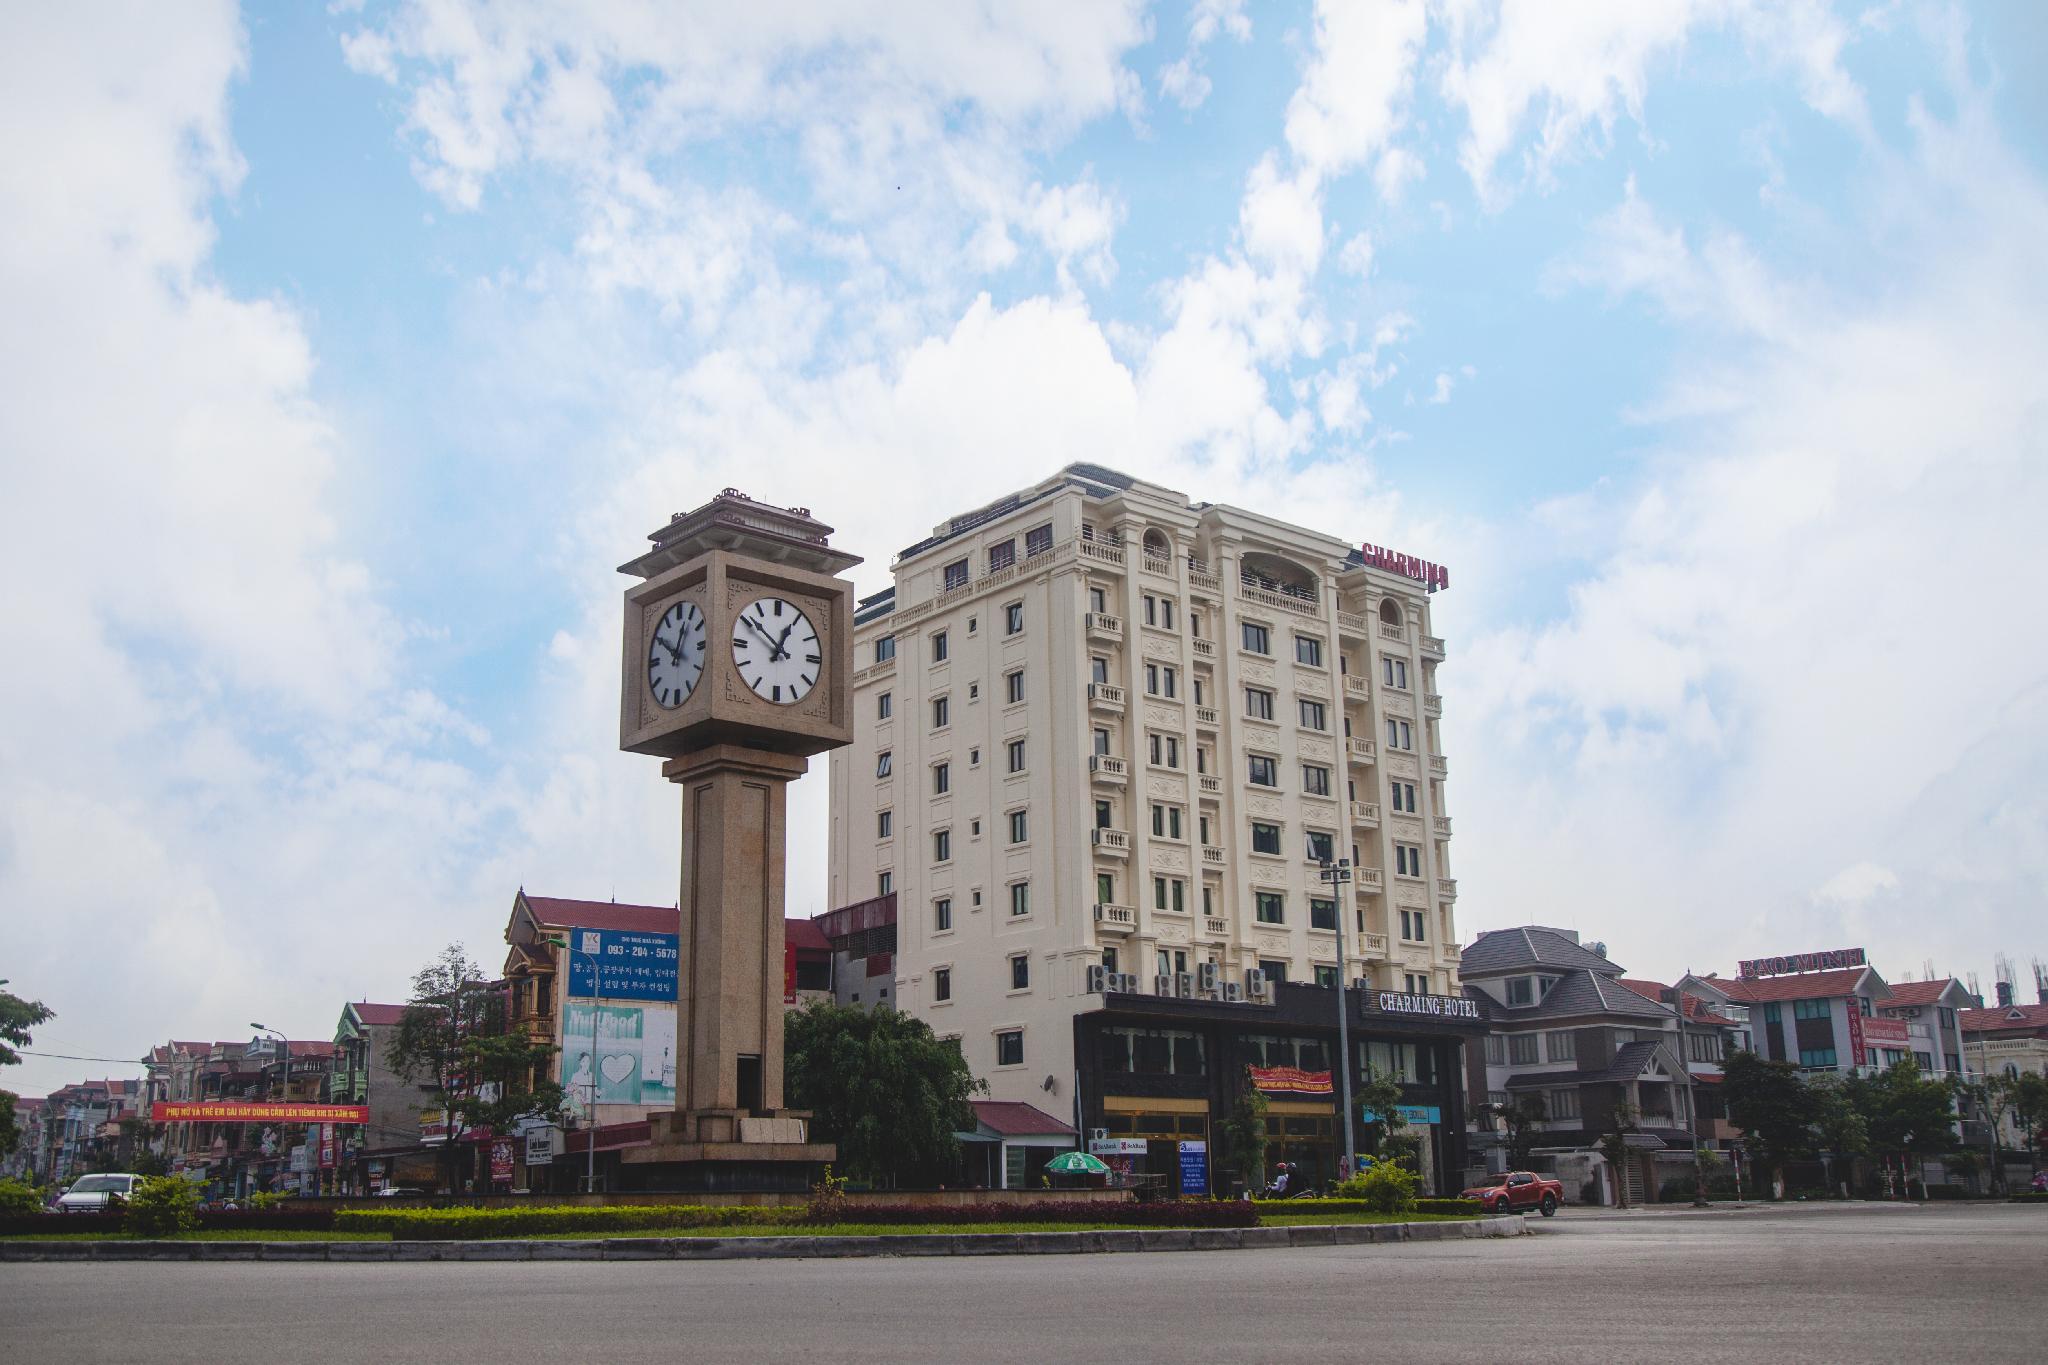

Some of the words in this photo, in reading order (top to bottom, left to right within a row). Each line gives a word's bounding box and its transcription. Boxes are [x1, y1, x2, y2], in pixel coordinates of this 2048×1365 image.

[607, 944, 624, 955] 093
[655, 947, 677, 959] 5678
[1380, 992, 1440, 1015] CHARMING
[1444, 998, 1479, 1018] HOTEL
[166, 1107, 180, 1118] PHỤ
[191, 1105, 201, 1116] VÀ
[214, 1107, 225, 1116] EM
